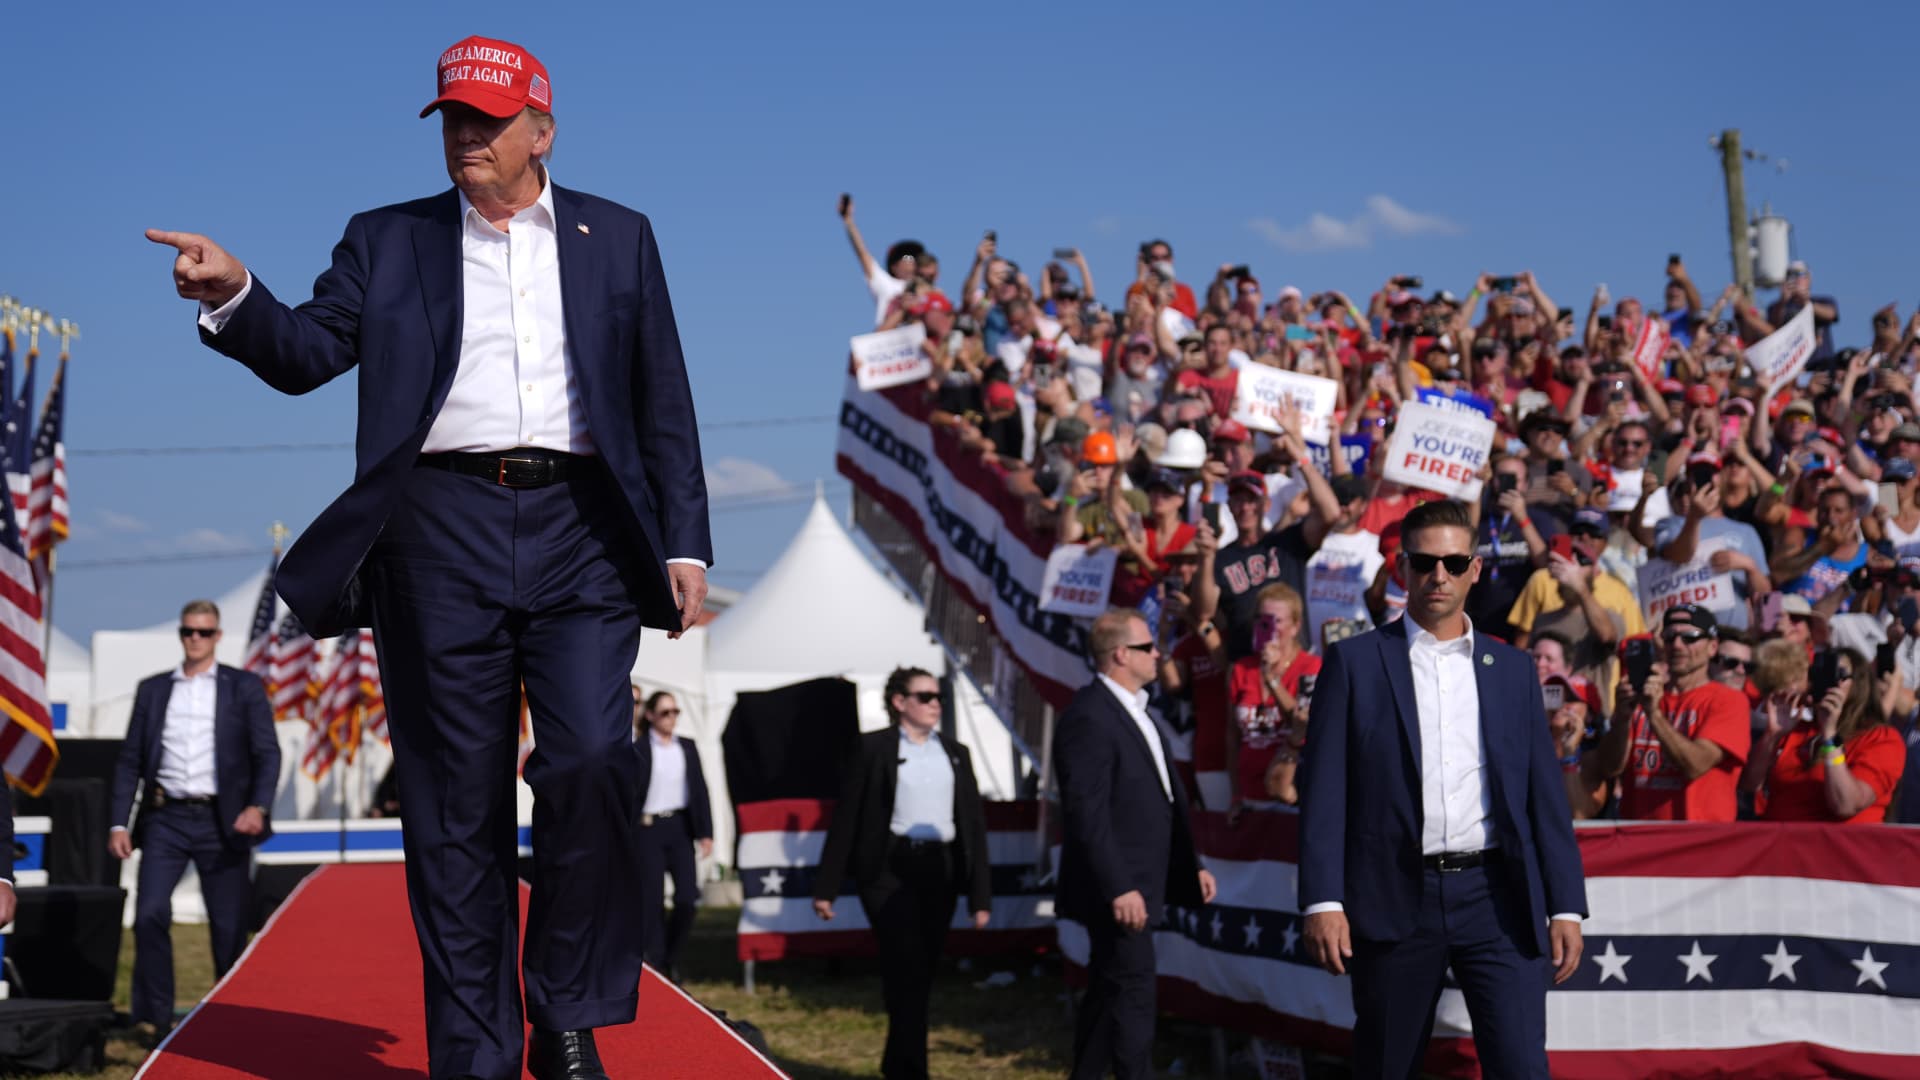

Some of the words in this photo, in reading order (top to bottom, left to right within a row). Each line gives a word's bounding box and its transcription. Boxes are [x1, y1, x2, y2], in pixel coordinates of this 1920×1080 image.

[464, 46, 522, 69] AMERICA
[472, 67, 513, 87] AGAIN
[1413, 431, 1484, 466] YOU'RE
[1223, 546, 1281, 595] USA
[1649, 564, 1711, 597] YOU'RE
[1649, 582, 1717, 617] FIRED!
